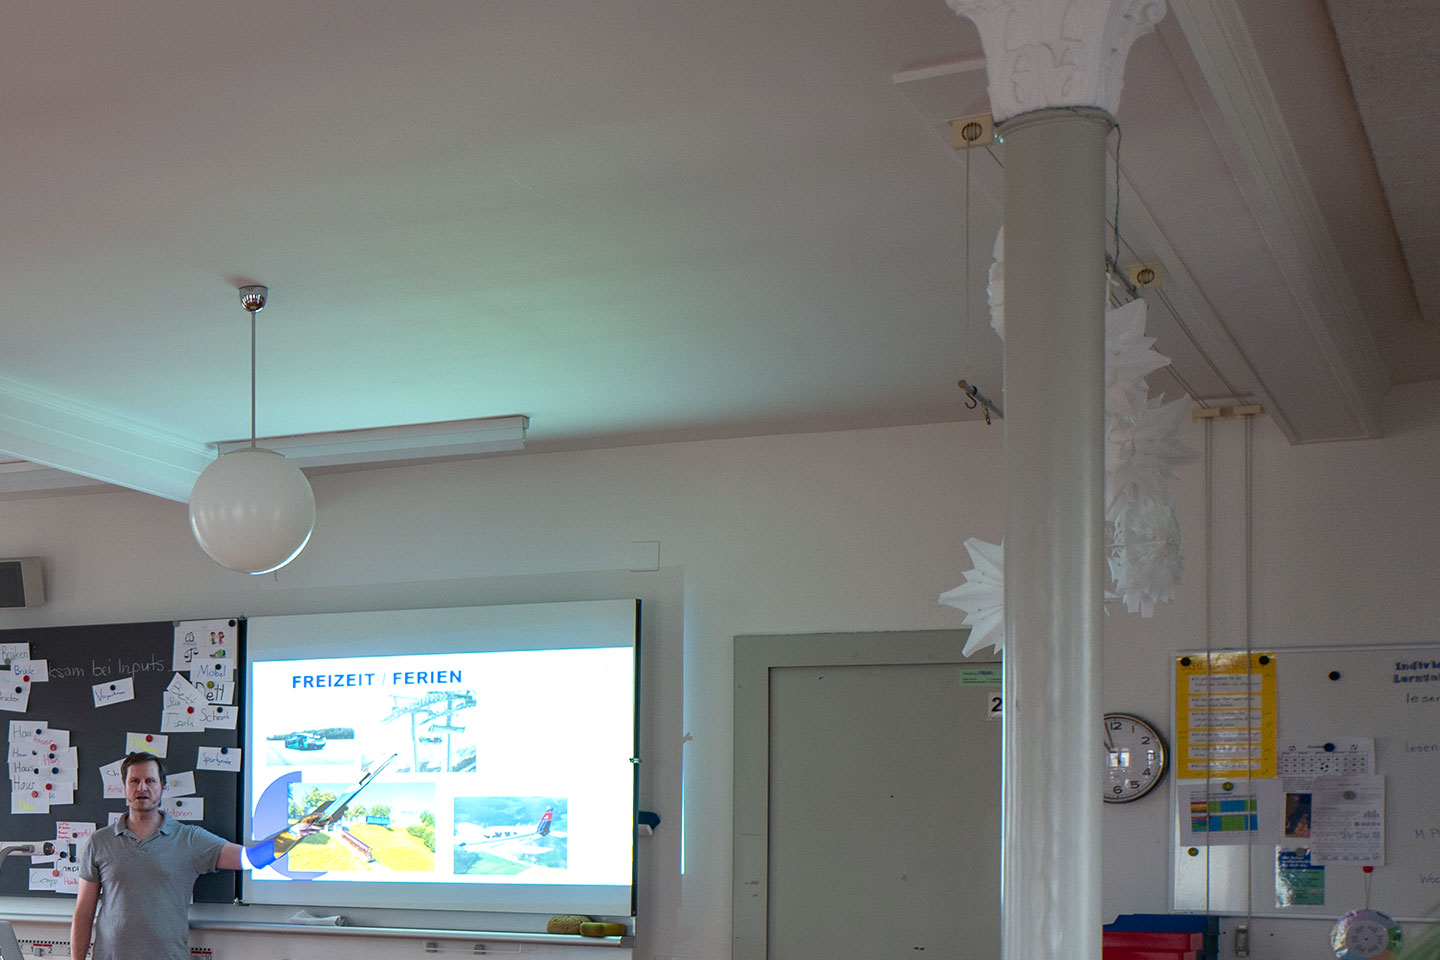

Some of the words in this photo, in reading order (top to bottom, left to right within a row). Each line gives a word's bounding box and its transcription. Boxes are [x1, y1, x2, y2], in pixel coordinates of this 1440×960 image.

[292, 673, 375, 688] FREIZEIT
[393, 670, 462, 685] FERIEN
[1110, 721, 1123, 730] 12
[1141, 736, 1151, 745] 2
[1142, 768, 1152, 777] 4
[1130, 780, 1141, 790] 5
[1112, 786, 1123, 795] 6
